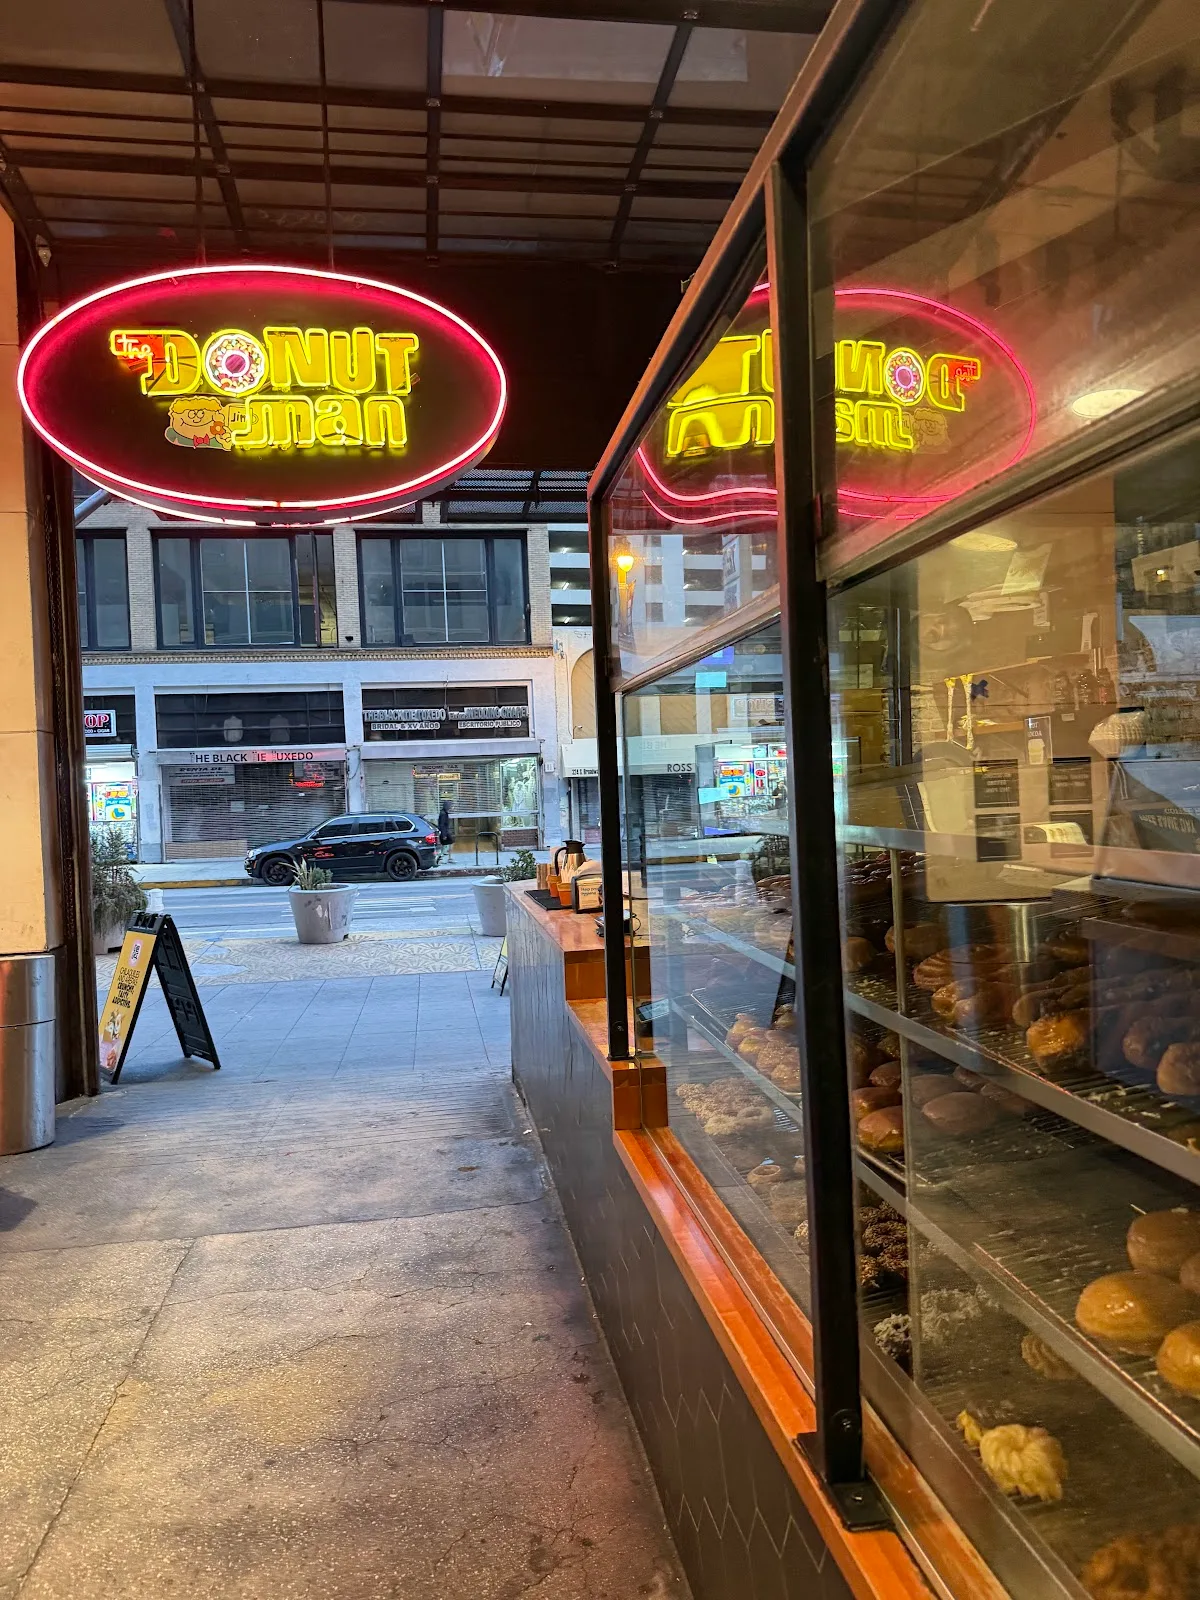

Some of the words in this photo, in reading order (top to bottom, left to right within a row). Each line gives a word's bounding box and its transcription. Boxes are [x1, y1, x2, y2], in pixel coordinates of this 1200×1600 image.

[115, 335, 152, 361] The
[109, 326, 420, 396] DONUT
[231, 394, 409, 449] man
[84, 713, 110, 729] OP
[371, 722, 398, 730] BRIDAL
[407, 722, 418, 730] XV
[458, 720, 494, 729] ESCRITORIO
[213, 752, 248, 762] BLACK
[667, 763, 693, 773] ROSS
